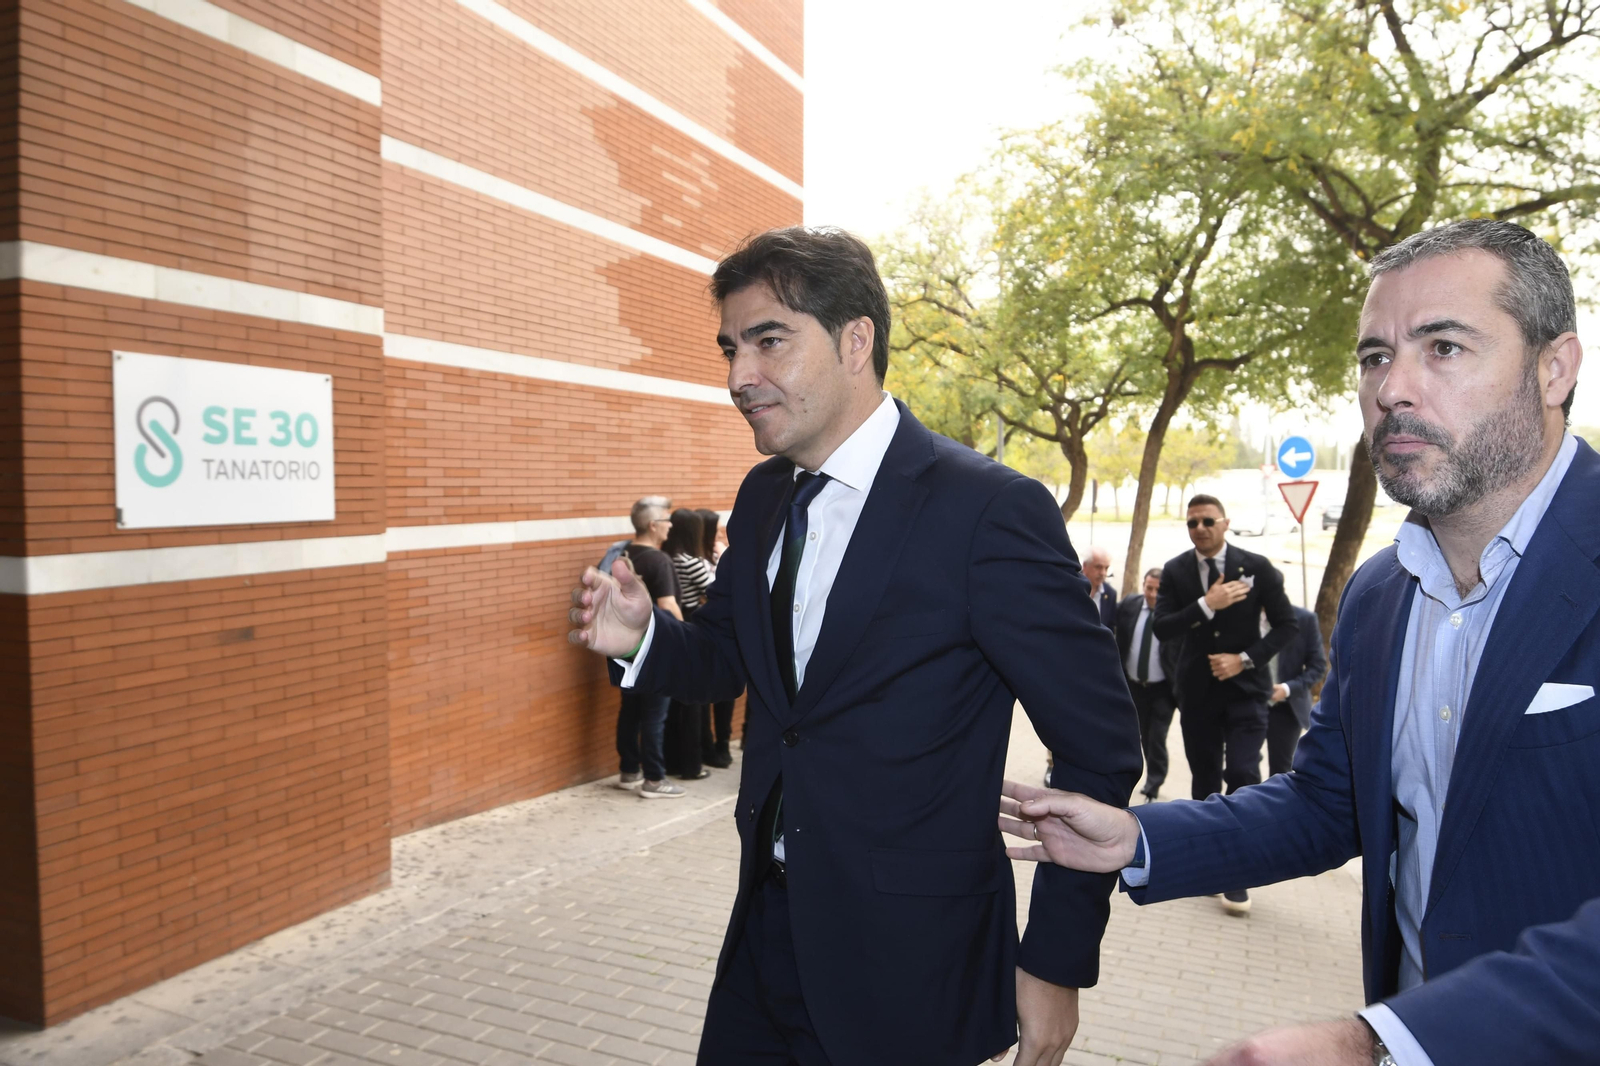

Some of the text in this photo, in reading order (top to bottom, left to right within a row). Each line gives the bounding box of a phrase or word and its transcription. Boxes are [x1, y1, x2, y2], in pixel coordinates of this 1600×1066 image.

[202, 405, 319, 448] SE 30
[202, 458, 321, 481] TANATORIO
